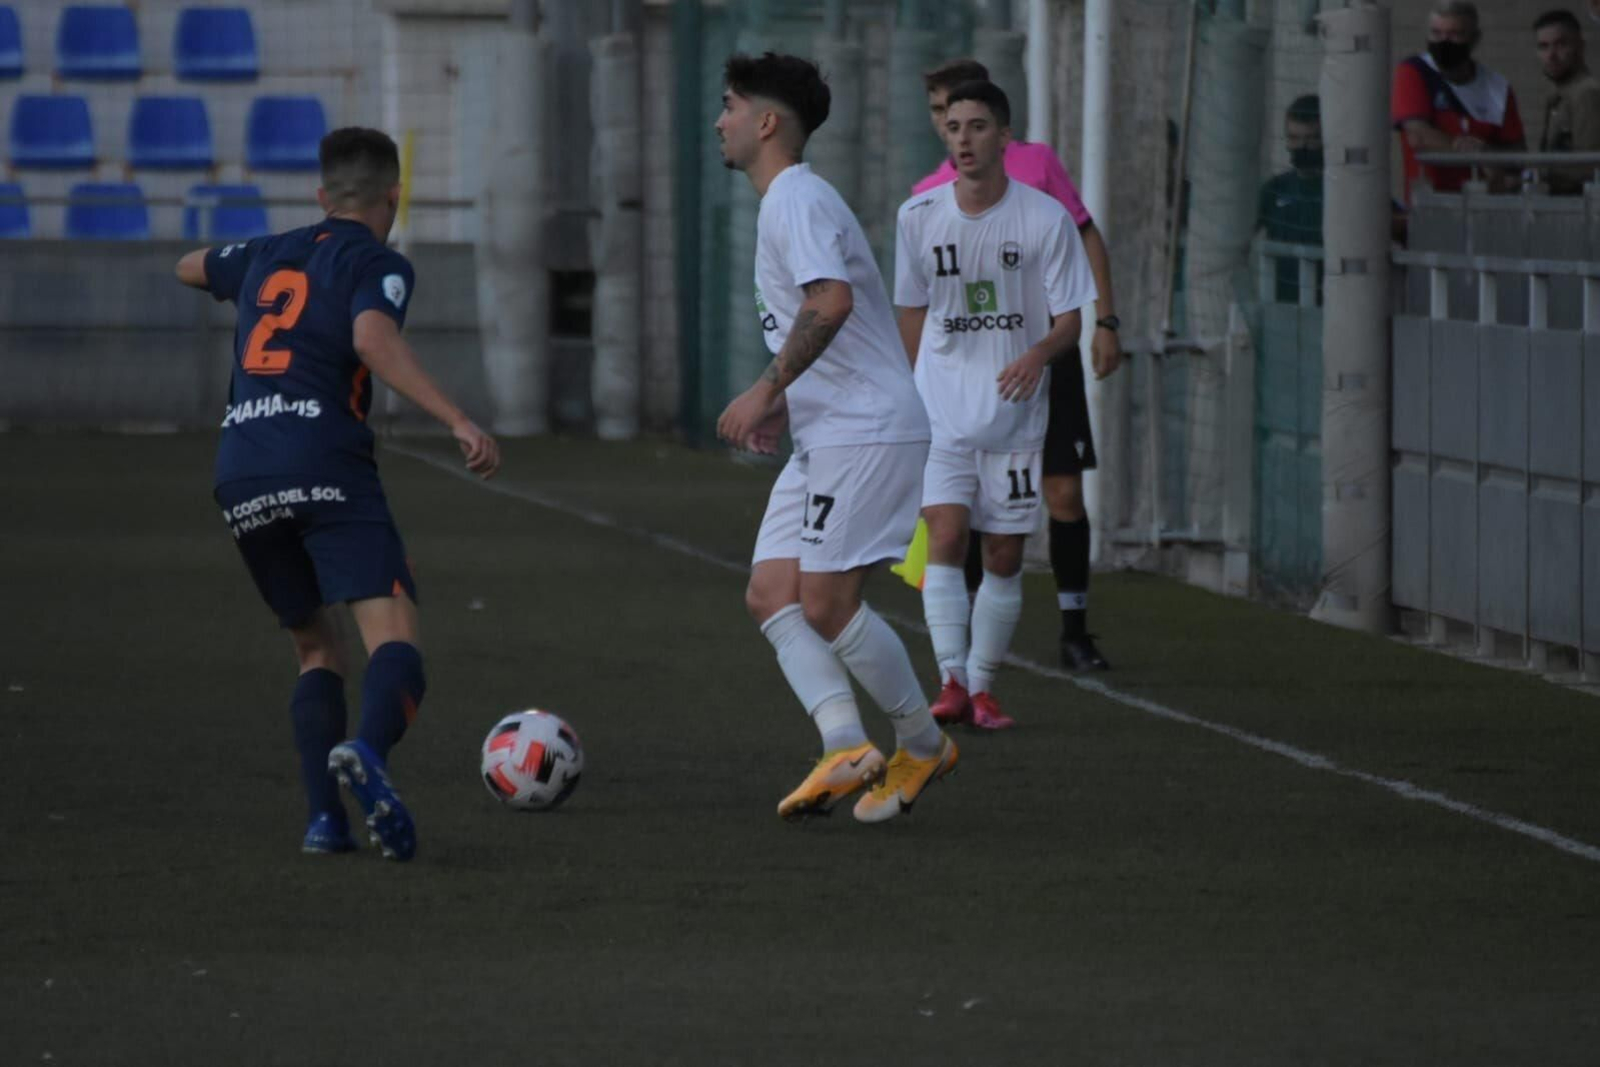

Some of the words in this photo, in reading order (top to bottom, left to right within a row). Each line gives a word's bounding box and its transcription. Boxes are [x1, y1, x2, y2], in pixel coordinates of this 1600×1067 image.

[933, 244, 960, 277] 11
[242, 268, 309, 374] 2
[1008, 468, 1036, 500] 11
[232, 493, 278, 519] COSTA
[278, 488, 308, 504] DEL
[311, 486, 345, 501] SOL
